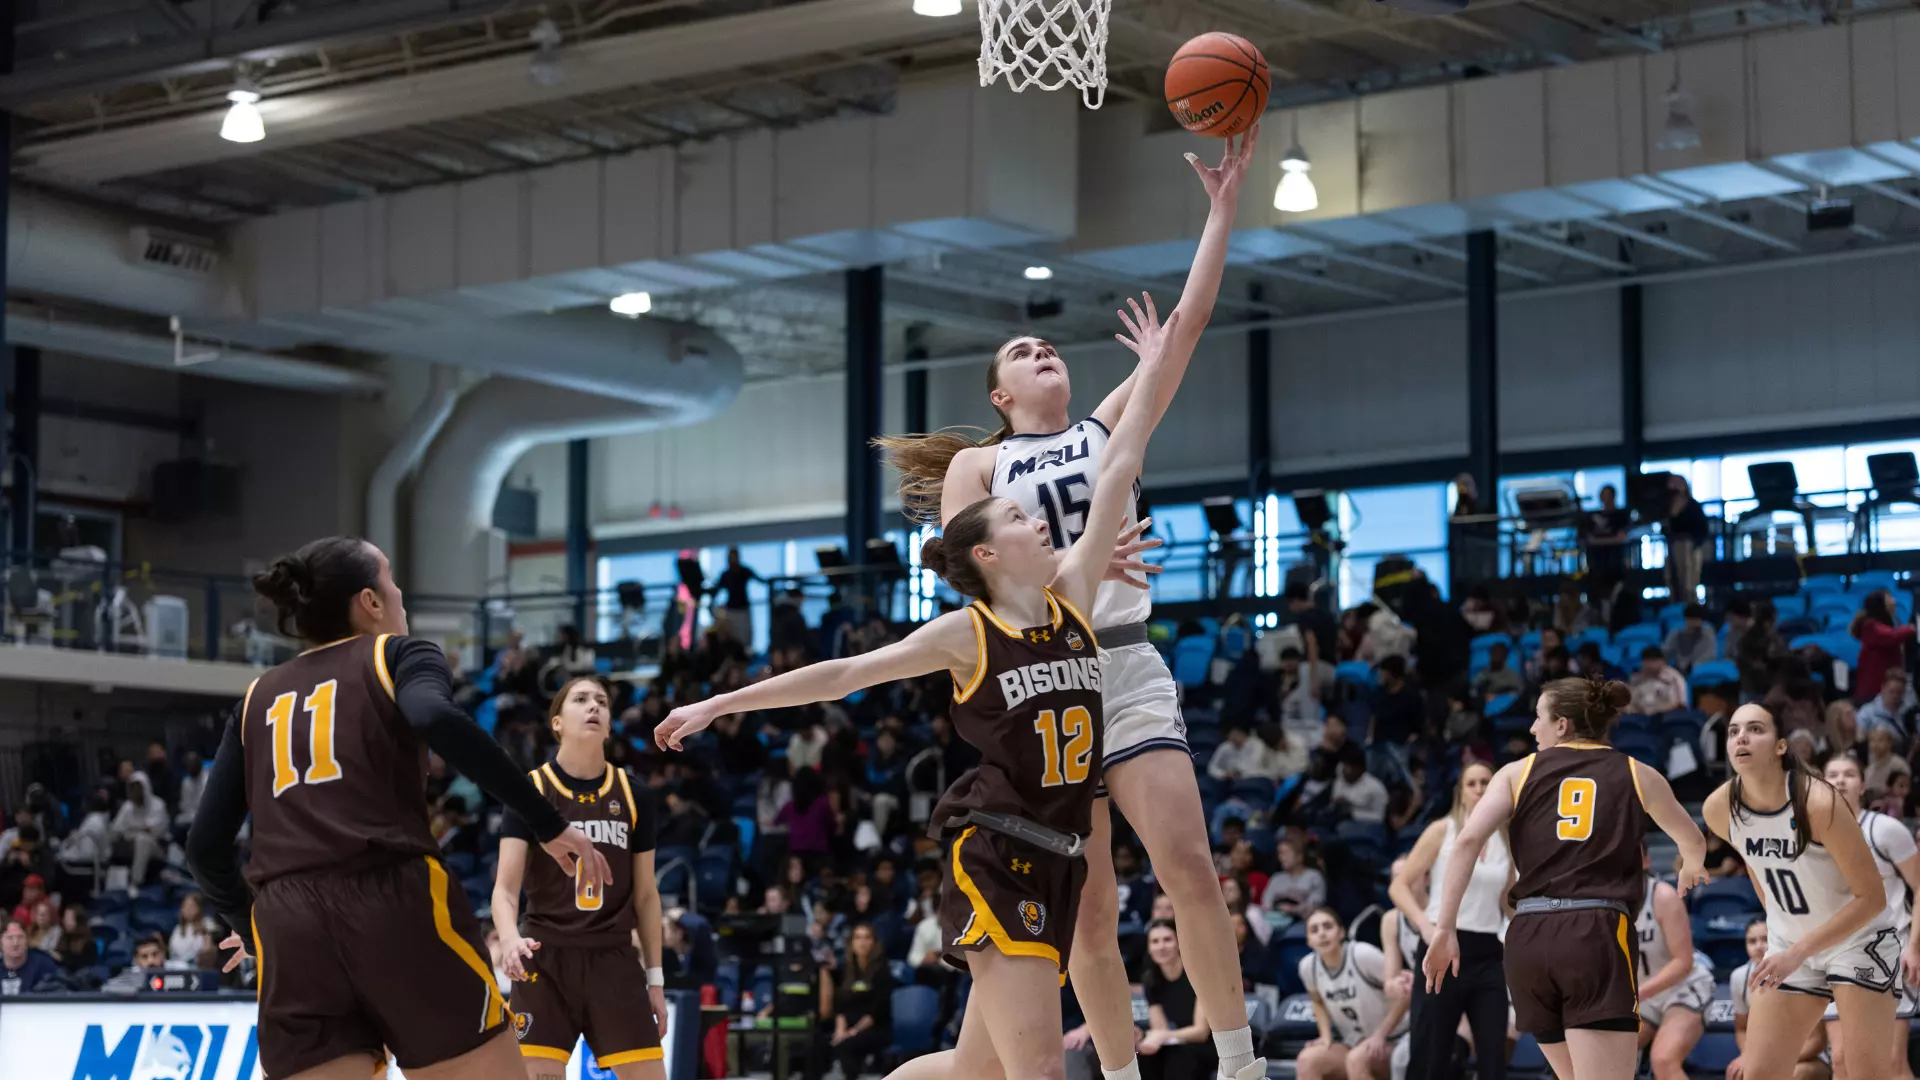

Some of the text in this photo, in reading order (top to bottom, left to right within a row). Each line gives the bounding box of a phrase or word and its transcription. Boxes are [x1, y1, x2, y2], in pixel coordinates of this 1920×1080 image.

[1008, 437, 1089, 484] MRU
[1036, 472, 1092, 549] 15
[996, 657, 1102, 711] BISONS
[266, 678, 342, 798] 11
[1033, 705, 1093, 787] 12
[1556, 777, 1597, 841] 9
[1746, 837, 1797, 859] MRU
[1764, 867, 1810, 915] 10
